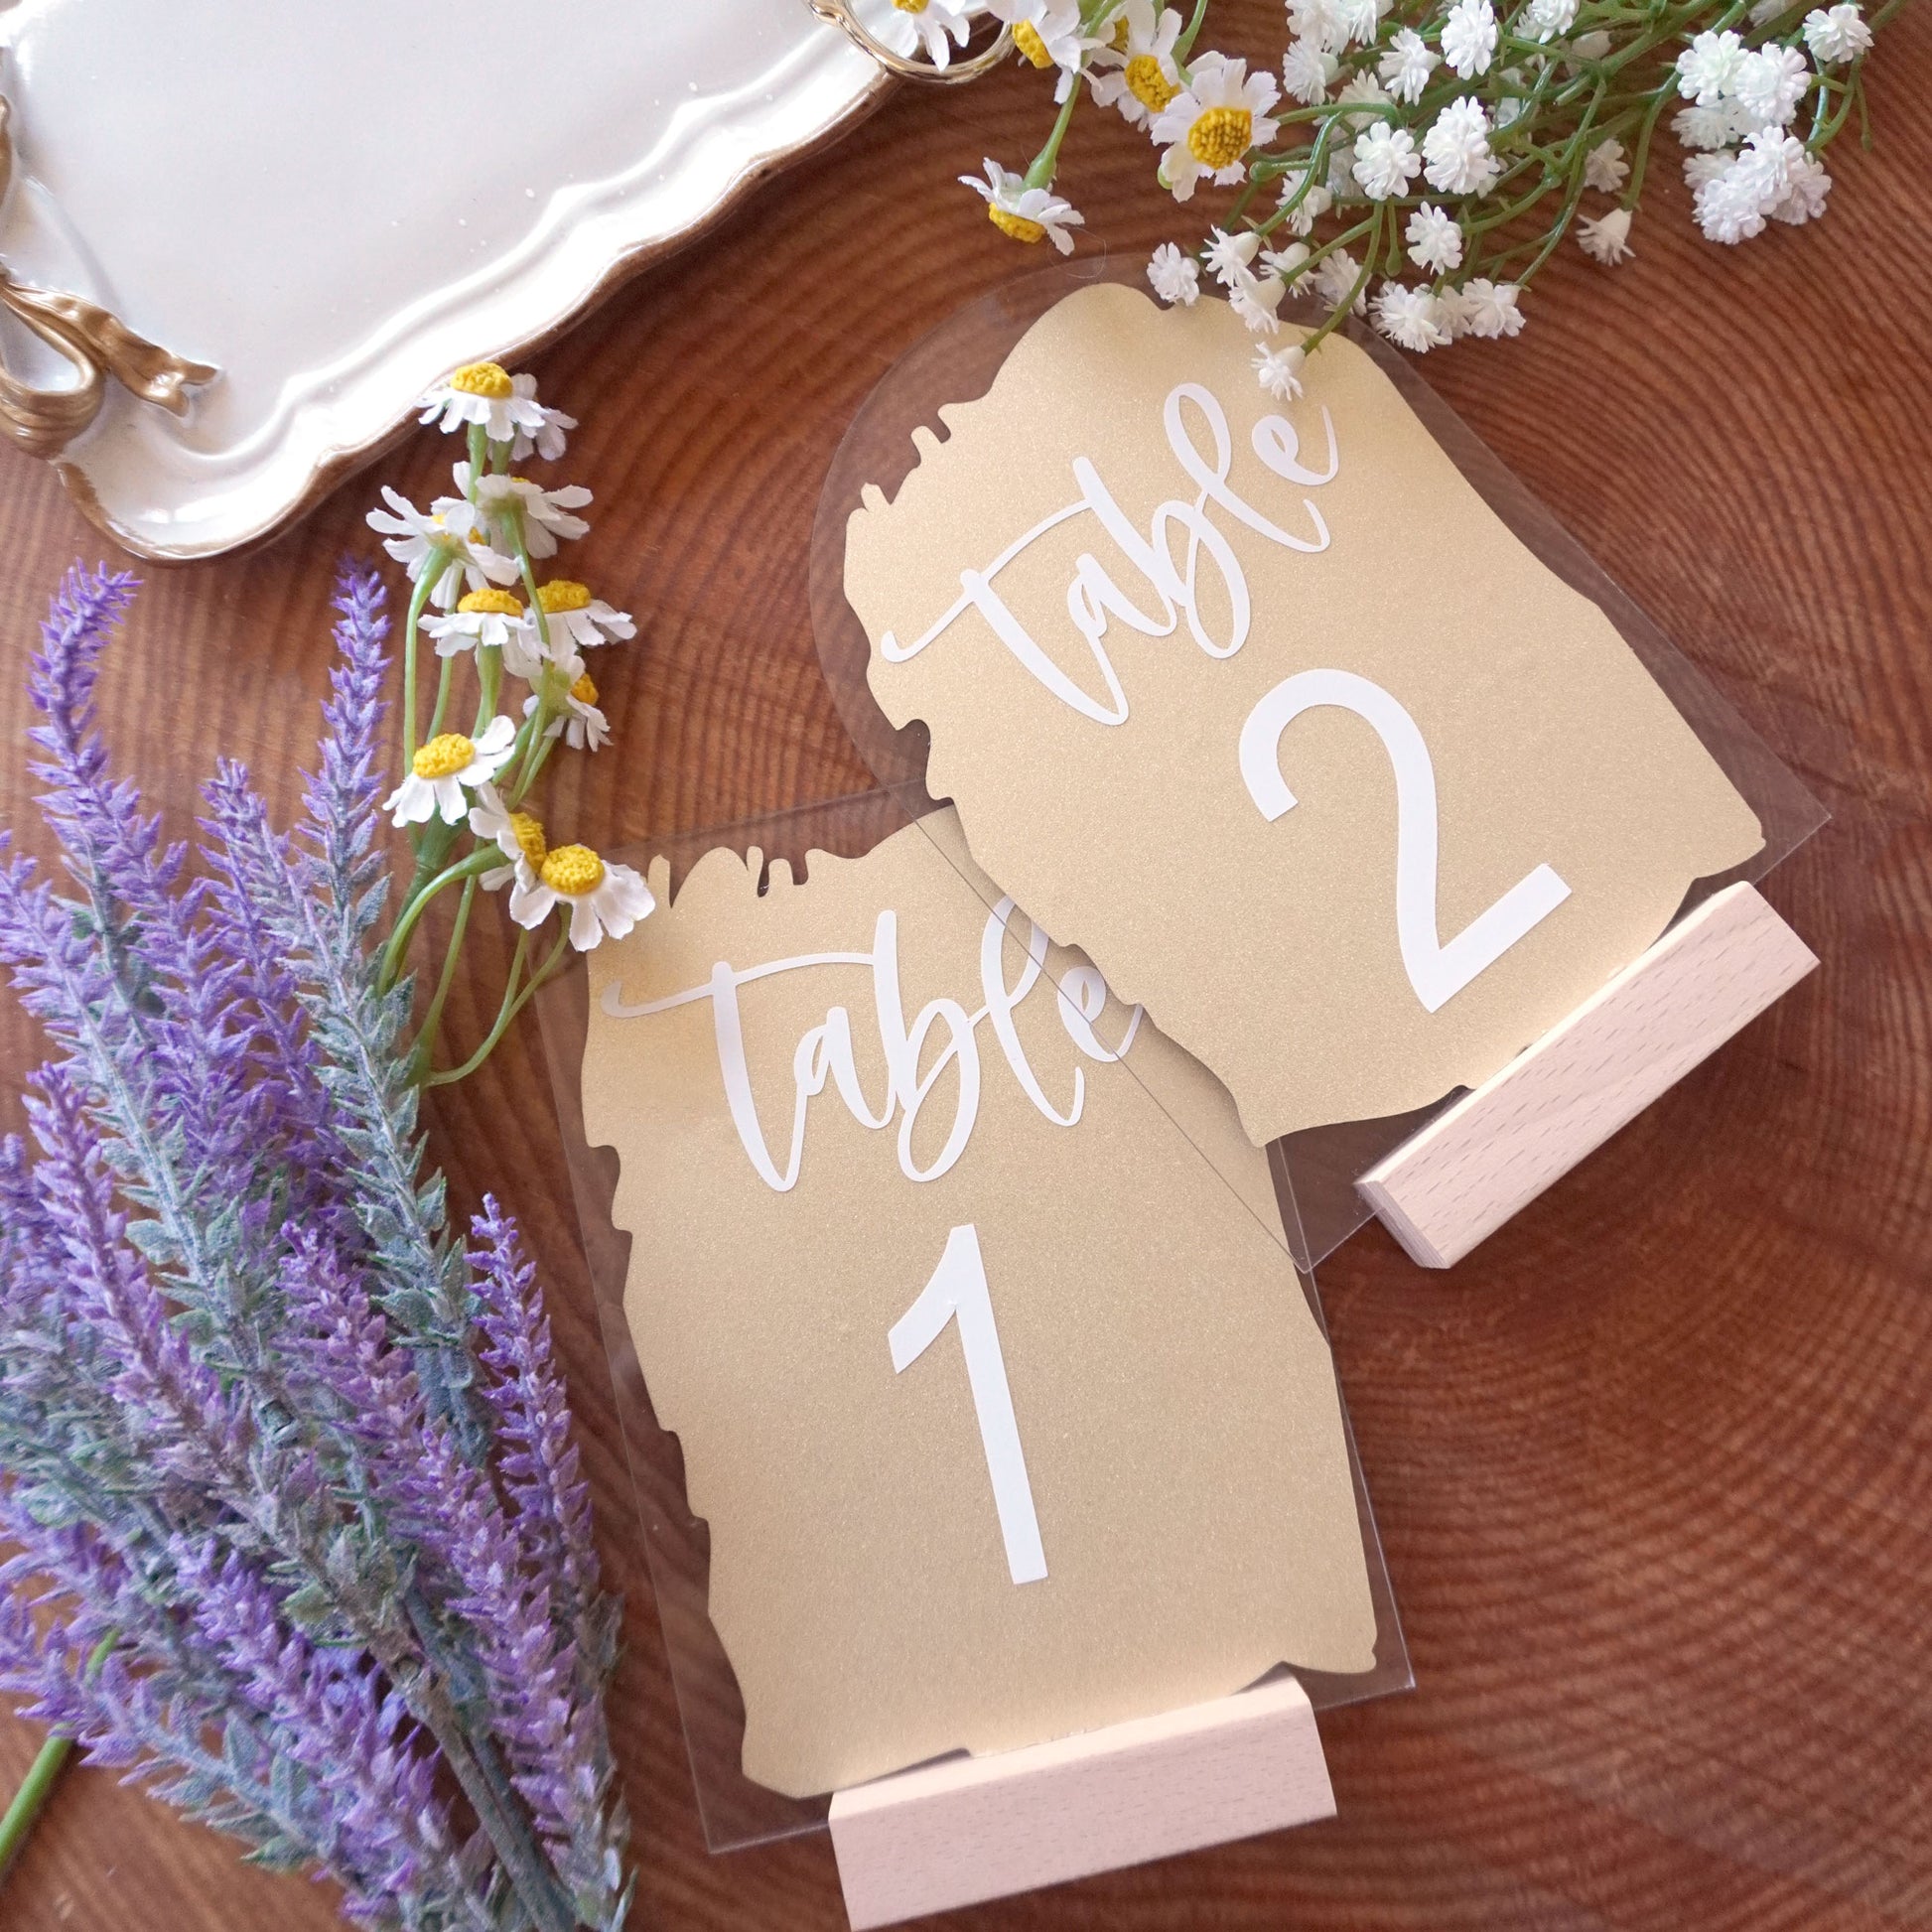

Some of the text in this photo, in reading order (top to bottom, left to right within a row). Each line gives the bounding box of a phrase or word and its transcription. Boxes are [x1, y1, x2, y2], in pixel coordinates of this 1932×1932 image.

[881, 382, 1339, 726] Table
[1239, 668, 1572, 1013] 2
[888, 1224, 1048, 1585] 1
